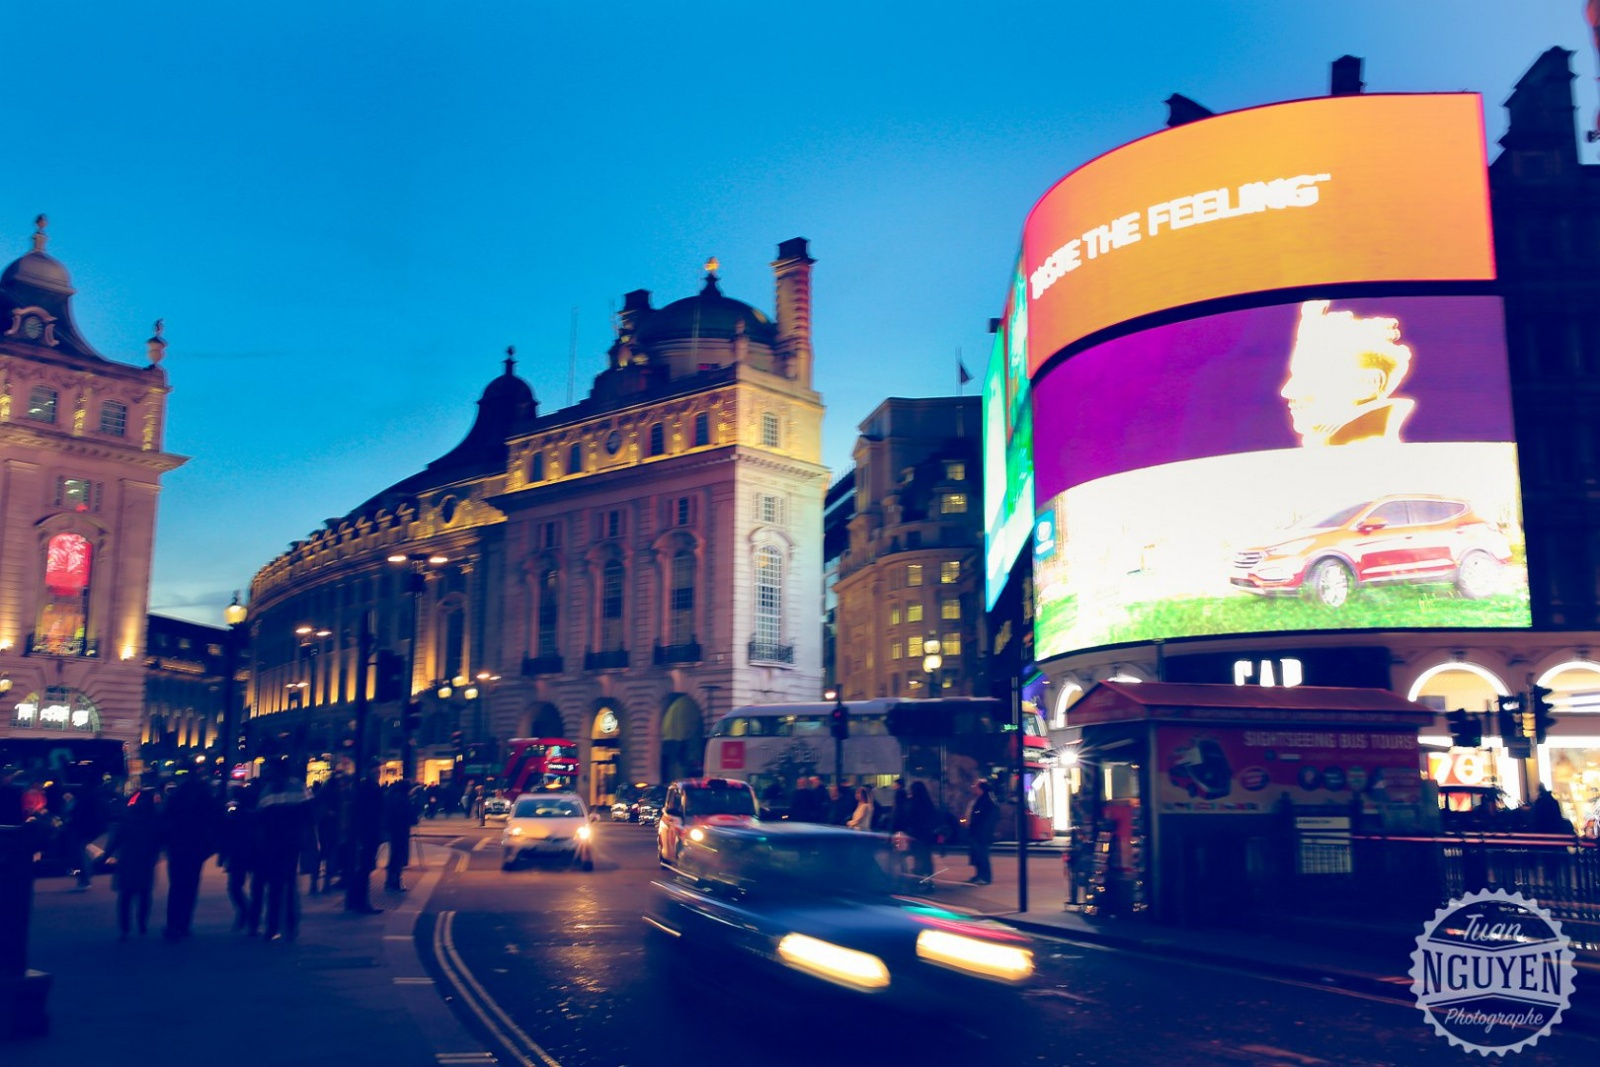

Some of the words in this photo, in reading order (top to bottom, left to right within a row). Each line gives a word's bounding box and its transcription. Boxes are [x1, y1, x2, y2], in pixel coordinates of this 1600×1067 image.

[1082, 211, 1142, 260] THE
[1243, 731, 1336, 748] SIGHTSEEING
[1339, 732, 1367, 749] BUS
[1370, 733, 1417, 750] TOURS
